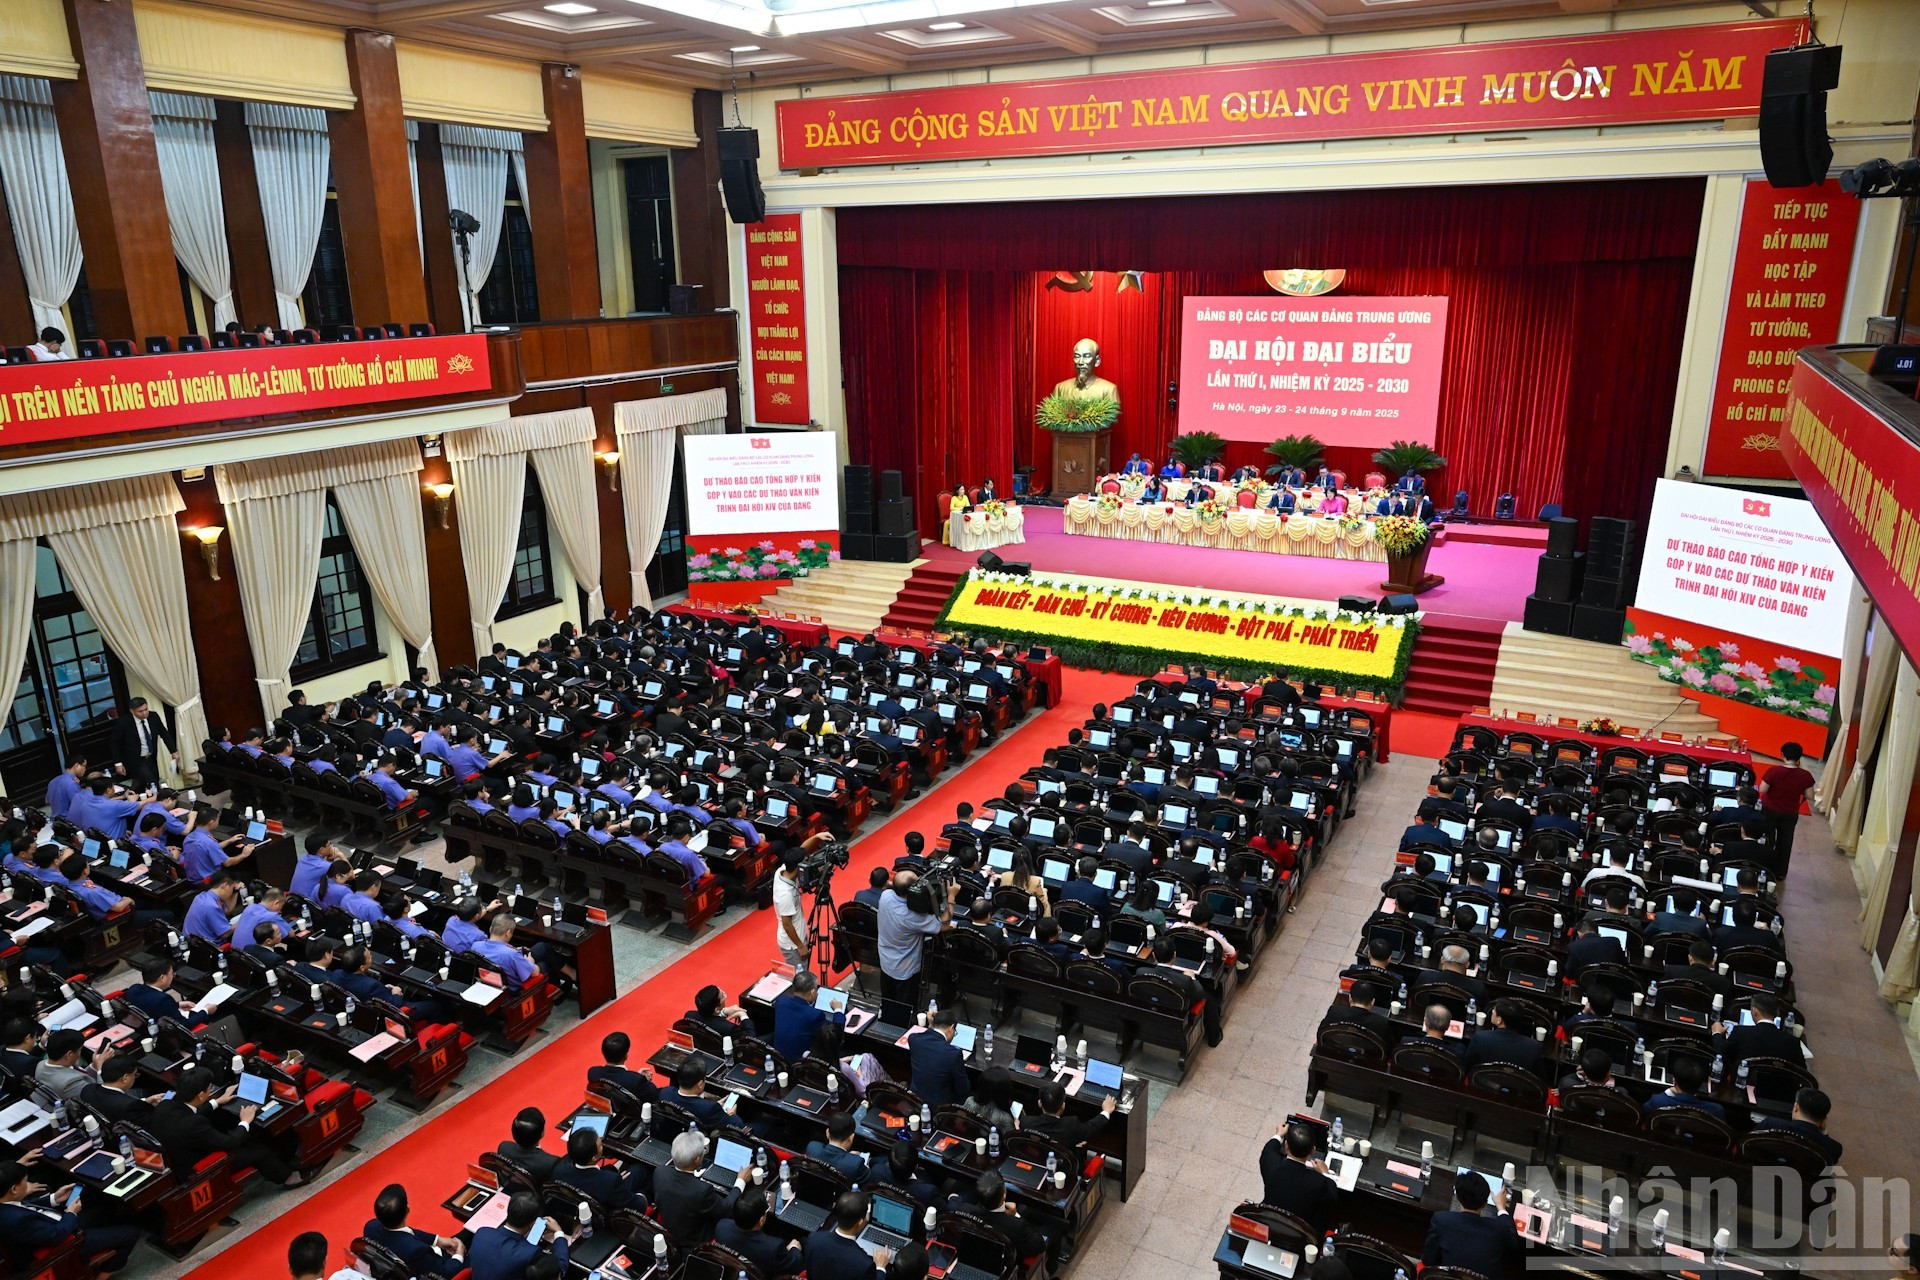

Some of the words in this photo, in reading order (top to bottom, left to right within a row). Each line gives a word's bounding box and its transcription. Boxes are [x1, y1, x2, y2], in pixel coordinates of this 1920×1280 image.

[805, 110, 882, 148] ĐẢNG
[890, 107, 969, 148] CỘNG
[978, 97, 1038, 137] SẢN
[1047, 94, 1122, 138] VIỆT
[1131, 94, 1209, 127] NAM
[1221, 84, 1351, 122] QUANG
[1361, 76, 1467, 112] VINH
[1480, 58, 1616, 106] MUÔN
[1629, 49, 1746, 97] NĂM
[1773, 198, 1801, 220] TIẾP
[1804, 203, 1828, 222] TỤC
[750, 230, 766, 243] ĐẢNG
[767, 229, 783, 245] CỘNG
[784, 228, 797, 242] SẢN
[1762, 227, 1788, 249] ĐẨY
[1790, 233, 1829, 252] MẠNH
[761, 255, 773, 269] VIỆT
[774, 255, 788, 267] NAM
[1764, 263, 1790, 283] HỌC
[1793, 260, 1817, 282] TẬP
[765, 300, 772, 315] TỔ
[773, 302, 789, 315] CHỨC
[1746, 292, 1762, 308] VÀ
[1764, 291, 1792, 308] LÀM
[1794, 292, 1826, 308] THEO
[1197, 307, 1226, 322] ĐẢNG
[1228, 309, 1243, 324] BỘ
[1246, 309, 1268, 322] CÁC
[1270, 310, 1287, 323] CƠ
[1289, 311, 1319, 323] QUAN
[1321, 308, 1353, 323] ĐẢNG
[1356, 311, 1395, 323] TRUNG
[1398, 311, 1431, 324] ƯƠNG
[757, 327, 769, 340] MỌI
[769, 325, 788, 339] THẮNG
[789, 326, 799, 340] LỢI
[1750, 321, 1766, 337] TƯ
[1768, 319, 1811, 340] TƯỞNG,
[756, 349, 768, 361] CỦA
[768, 348, 784, 361] CÁCH
[785, 350, 803, 363] MẠNG
[1209, 339, 1248, 365] ĐẠI
[1254, 335, 1296, 366] HỘI
[1302, 341, 1344, 368] ĐẠI
[1351, 332, 1413, 365] BIỂU
[1747, 350, 1772, 369] ĐẠO
[1896, 359, 1913, 369] J.01
[12, 385, 61, 422] TRÊN
[62, 378, 100, 417] NỀN
[100, 375, 144, 412] TẢNG
[147, 369, 180, 408] CHỦ
[182, 369, 227, 404] NGHĨA
[229, 362, 308, 399] MÁC-LÊNIN,
[308, 366, 325, 392] TƯ
[325, 358, 365, 390] TƯỞNG
[367, 355, 383, 386] HỒ
[385, 354, 404, 384] CHÍ
[405, 356, 439, 383] MINH!
[765, 373, 778, 386] VIỆT
[779, 373, 795, 384] NAM!
[1207, 368, 1232, 388] LẦN
[1233, 371, 1257, 389] THỨ
[1259, 374, 1267, 391] I,
[1270, 372, 1310, 393] NHIỆM
[1314, 373, 1331, 391] KỲ
[1333, 376, 1365, 392] 2025
[1376, 378, 1409, 394] 2030
[1733, 378, 1774, 394] PHONG
[1777, 377, 1792, 394] CÁ
[1212, 402, 1225, 411] Hà
[1227, 402, 1246, 413] Nội,
[1248, 404, 1272, 415] ngày
[1275, 404, 1286, 413] 23
[1295, 405, 1307, 414] 24
[1309, 405, 1338, 418] tháng
[1341, 407, 1347, 416] 9
[1349, 407, 1372, 417] năm
[1374, 408, 1400, 418] 2025
[1726, 401, 1743, 421] HỒ
[1745, 404, 1767, 422] CHÍ
[1769, 407, 1785, 422] MI
[1739, 593, 1756, 606] XIV
[107, 930, 117, 944] K
[524, 1001, 531, 1015] J
[434, 1052, 445, 1067] K
[325, 1116, 336, 1132] L
[194, 1186, 210, 1204] M
